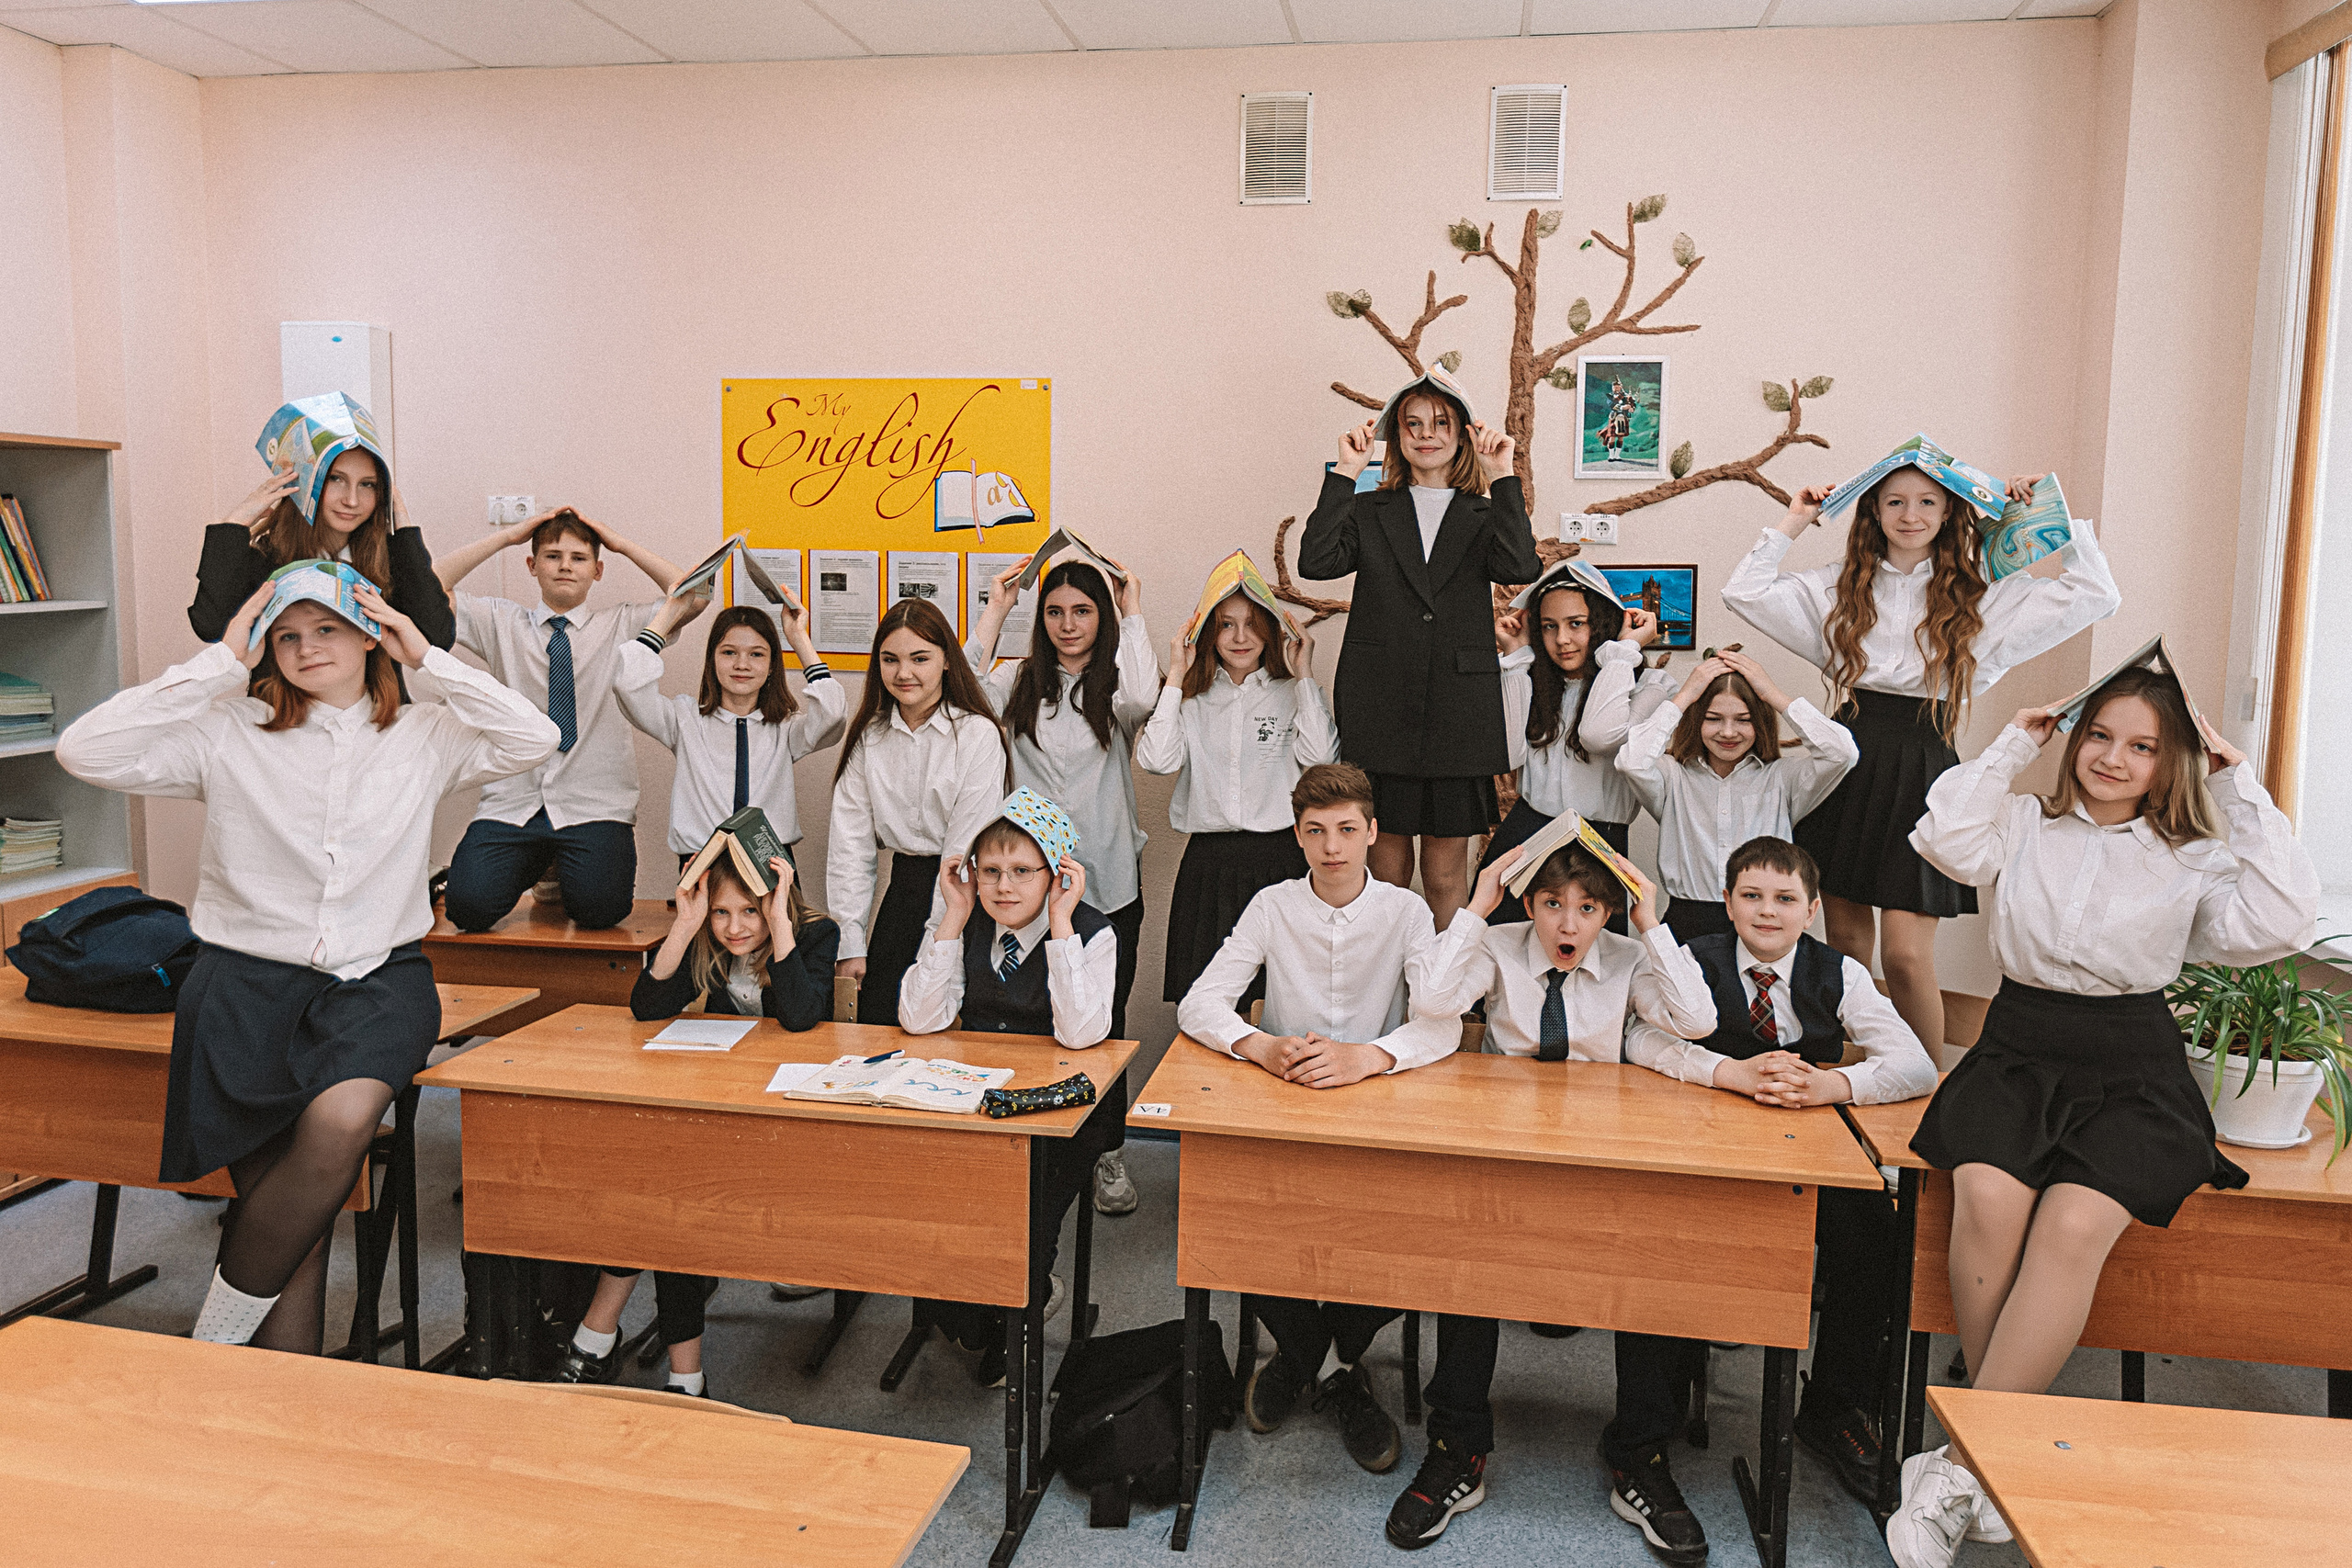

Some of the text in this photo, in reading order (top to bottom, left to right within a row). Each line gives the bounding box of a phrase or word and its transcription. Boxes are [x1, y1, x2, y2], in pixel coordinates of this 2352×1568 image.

[805, 392, 853, 435] My
[268, 442, 276, 456] 6
[737, 384, 1001, 520] English
[987, 484, 1003, 506] a
